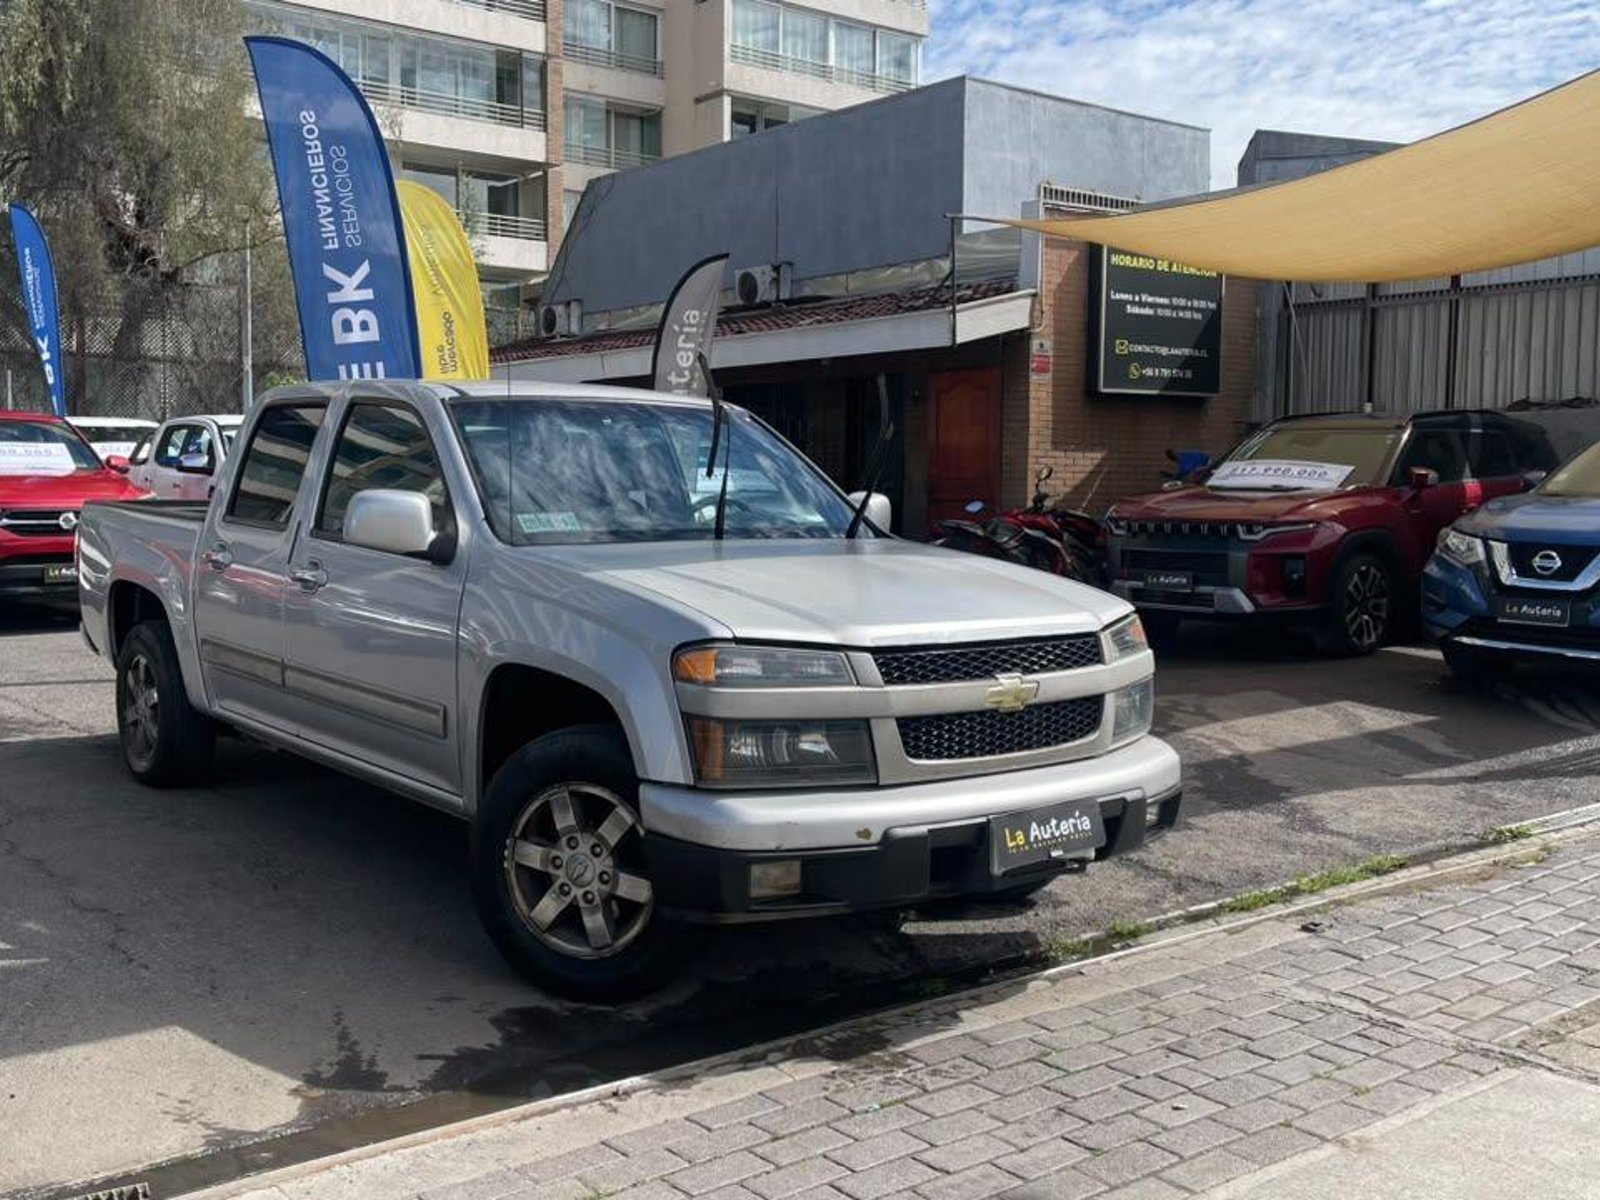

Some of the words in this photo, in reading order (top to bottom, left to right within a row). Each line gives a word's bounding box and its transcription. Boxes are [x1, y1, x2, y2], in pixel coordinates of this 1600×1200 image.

[1110, 253, 1155, 270] HORARIO
[1156, 259, 1170, 272] DE
[667, 308, 700, 397] tería
[1506, 604, 1518, 613] La
[1004, 827, 1026, 848] La
[1029, 809, 1092, 843] Autería
